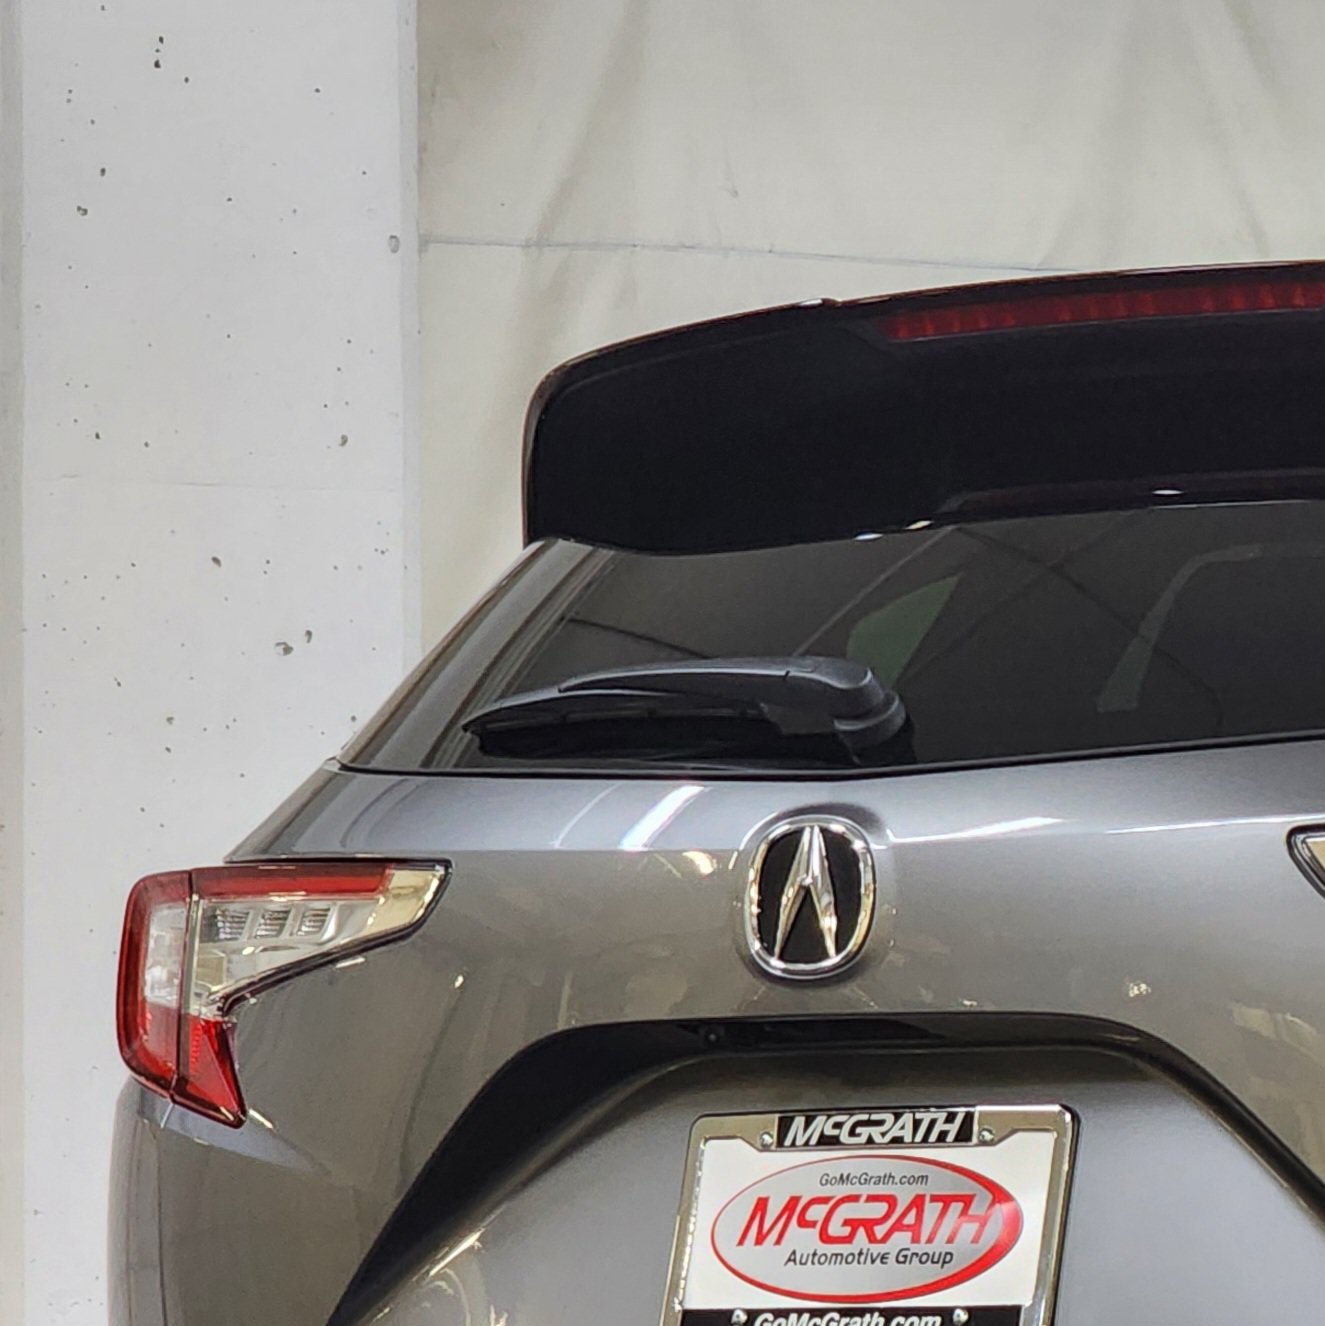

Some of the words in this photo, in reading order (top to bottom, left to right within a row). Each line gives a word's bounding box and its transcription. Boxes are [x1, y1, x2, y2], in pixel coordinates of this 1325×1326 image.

[819, 1172, 929, 1188] GoMcGrath.com
[784, 1248, 890, 1267] Automotive
[895, 1247, 954, 1270] Group
